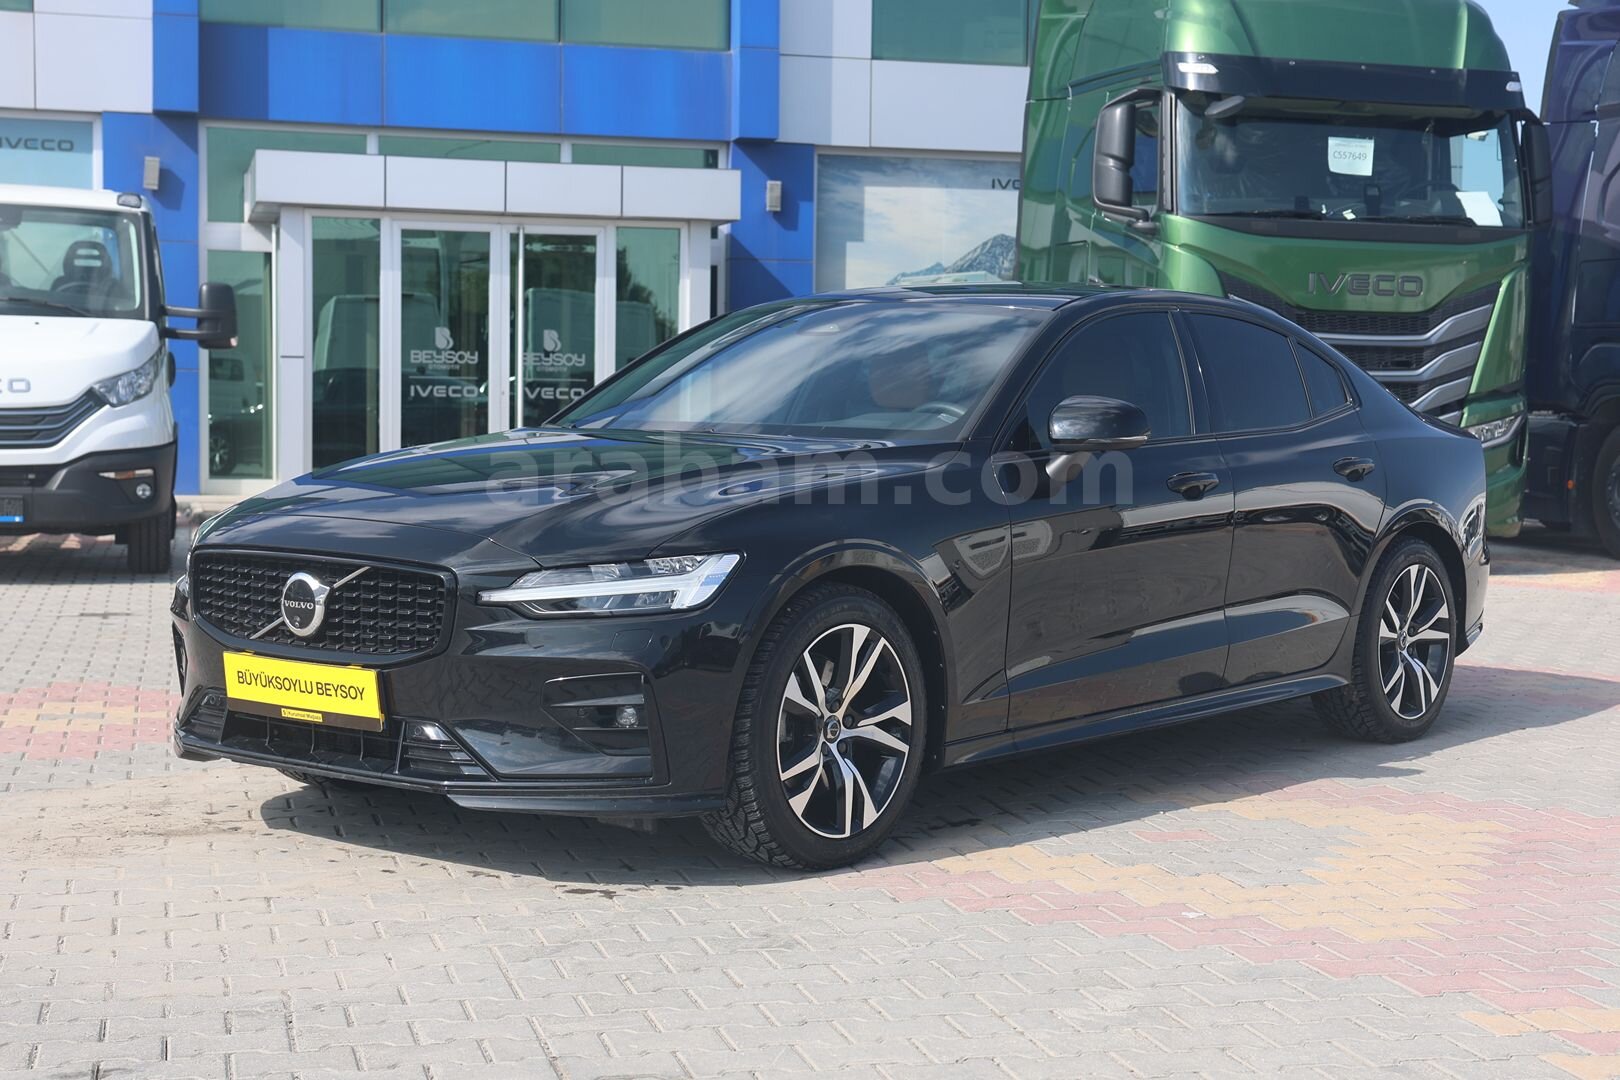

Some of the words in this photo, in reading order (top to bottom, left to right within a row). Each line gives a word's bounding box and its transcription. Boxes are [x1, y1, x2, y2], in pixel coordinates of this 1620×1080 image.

[1333, 150, 1367, 160] C557649
[991, 178, 1021, 190] IVE
[1307, 272, 1423, 297] IVECO
[410, 350, 479, 364] BEYSOY
[410, 385, 478, 397] IVECO
[524, 387, 585, 399] VECO
[284, 600, 314, 610] VOLVO
[237, 669, 313, 694] BÜYÜKSOYLU
[316, 681, 365, 700] BEYSOY
